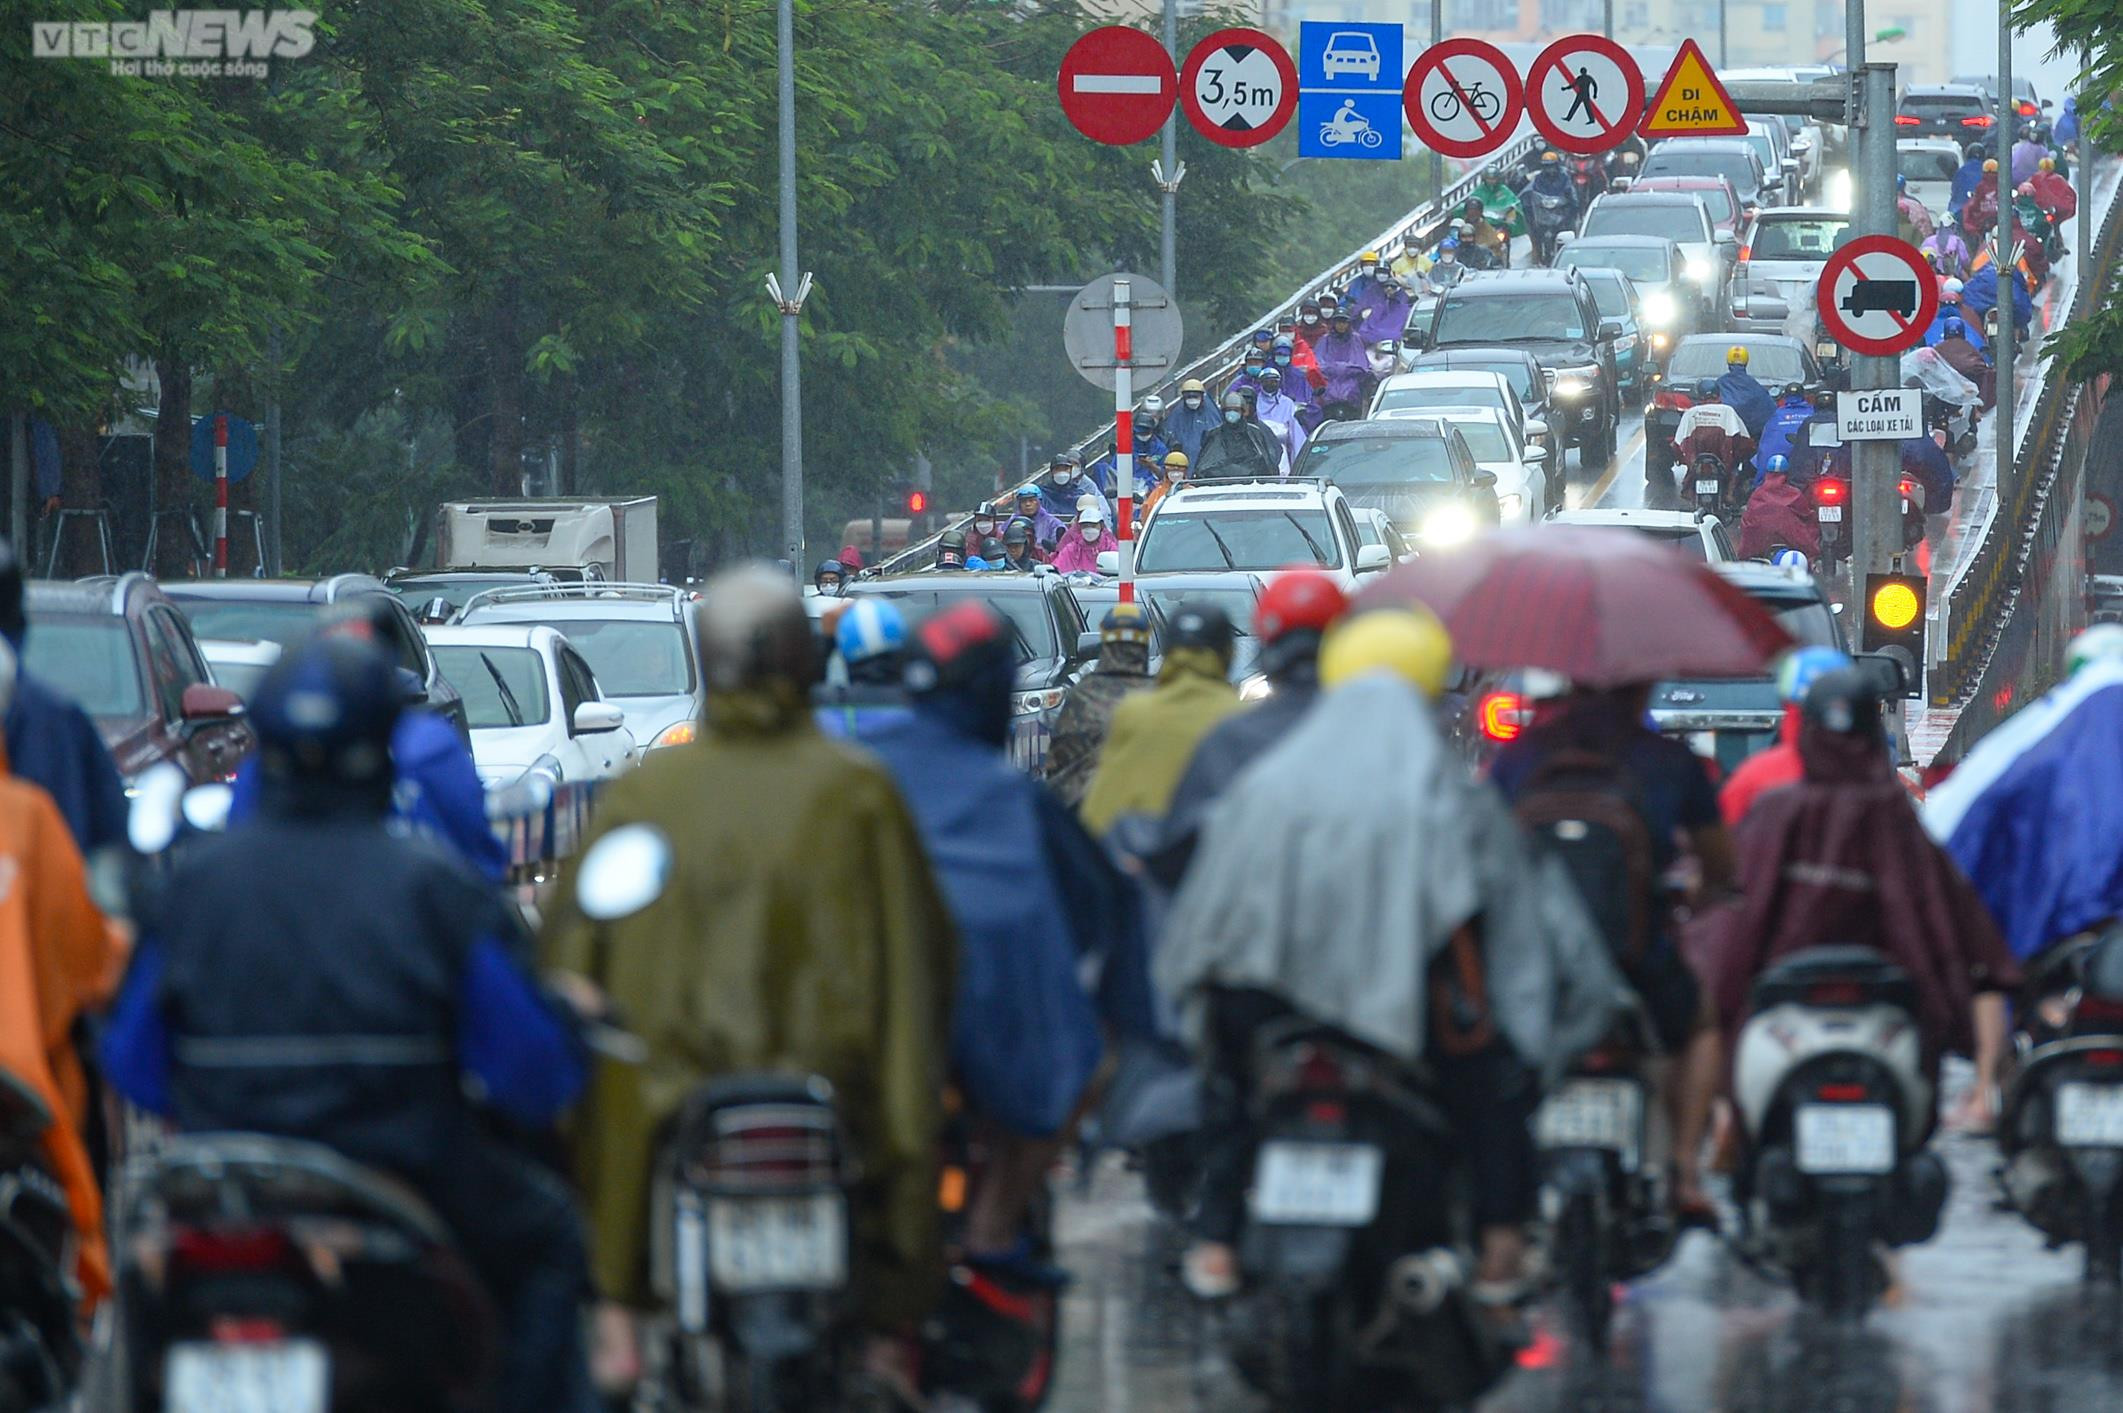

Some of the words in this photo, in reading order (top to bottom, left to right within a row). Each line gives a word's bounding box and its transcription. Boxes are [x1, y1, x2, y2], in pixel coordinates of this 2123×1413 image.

[1200, 69, 1274, 110] 3,5m
[1682, 88, 1700, 101] ĐI
[1666, 106, 1718, 126] CHẬM
[1858, 391, 1901, 413] CẤM
[1847, 419, 1864, 433] CÁC
[1866, 420, 1885, 434] LOẠI
[1887, 419, 1898, 432] XE
[1900, 414, 1913, 431] TẢI
